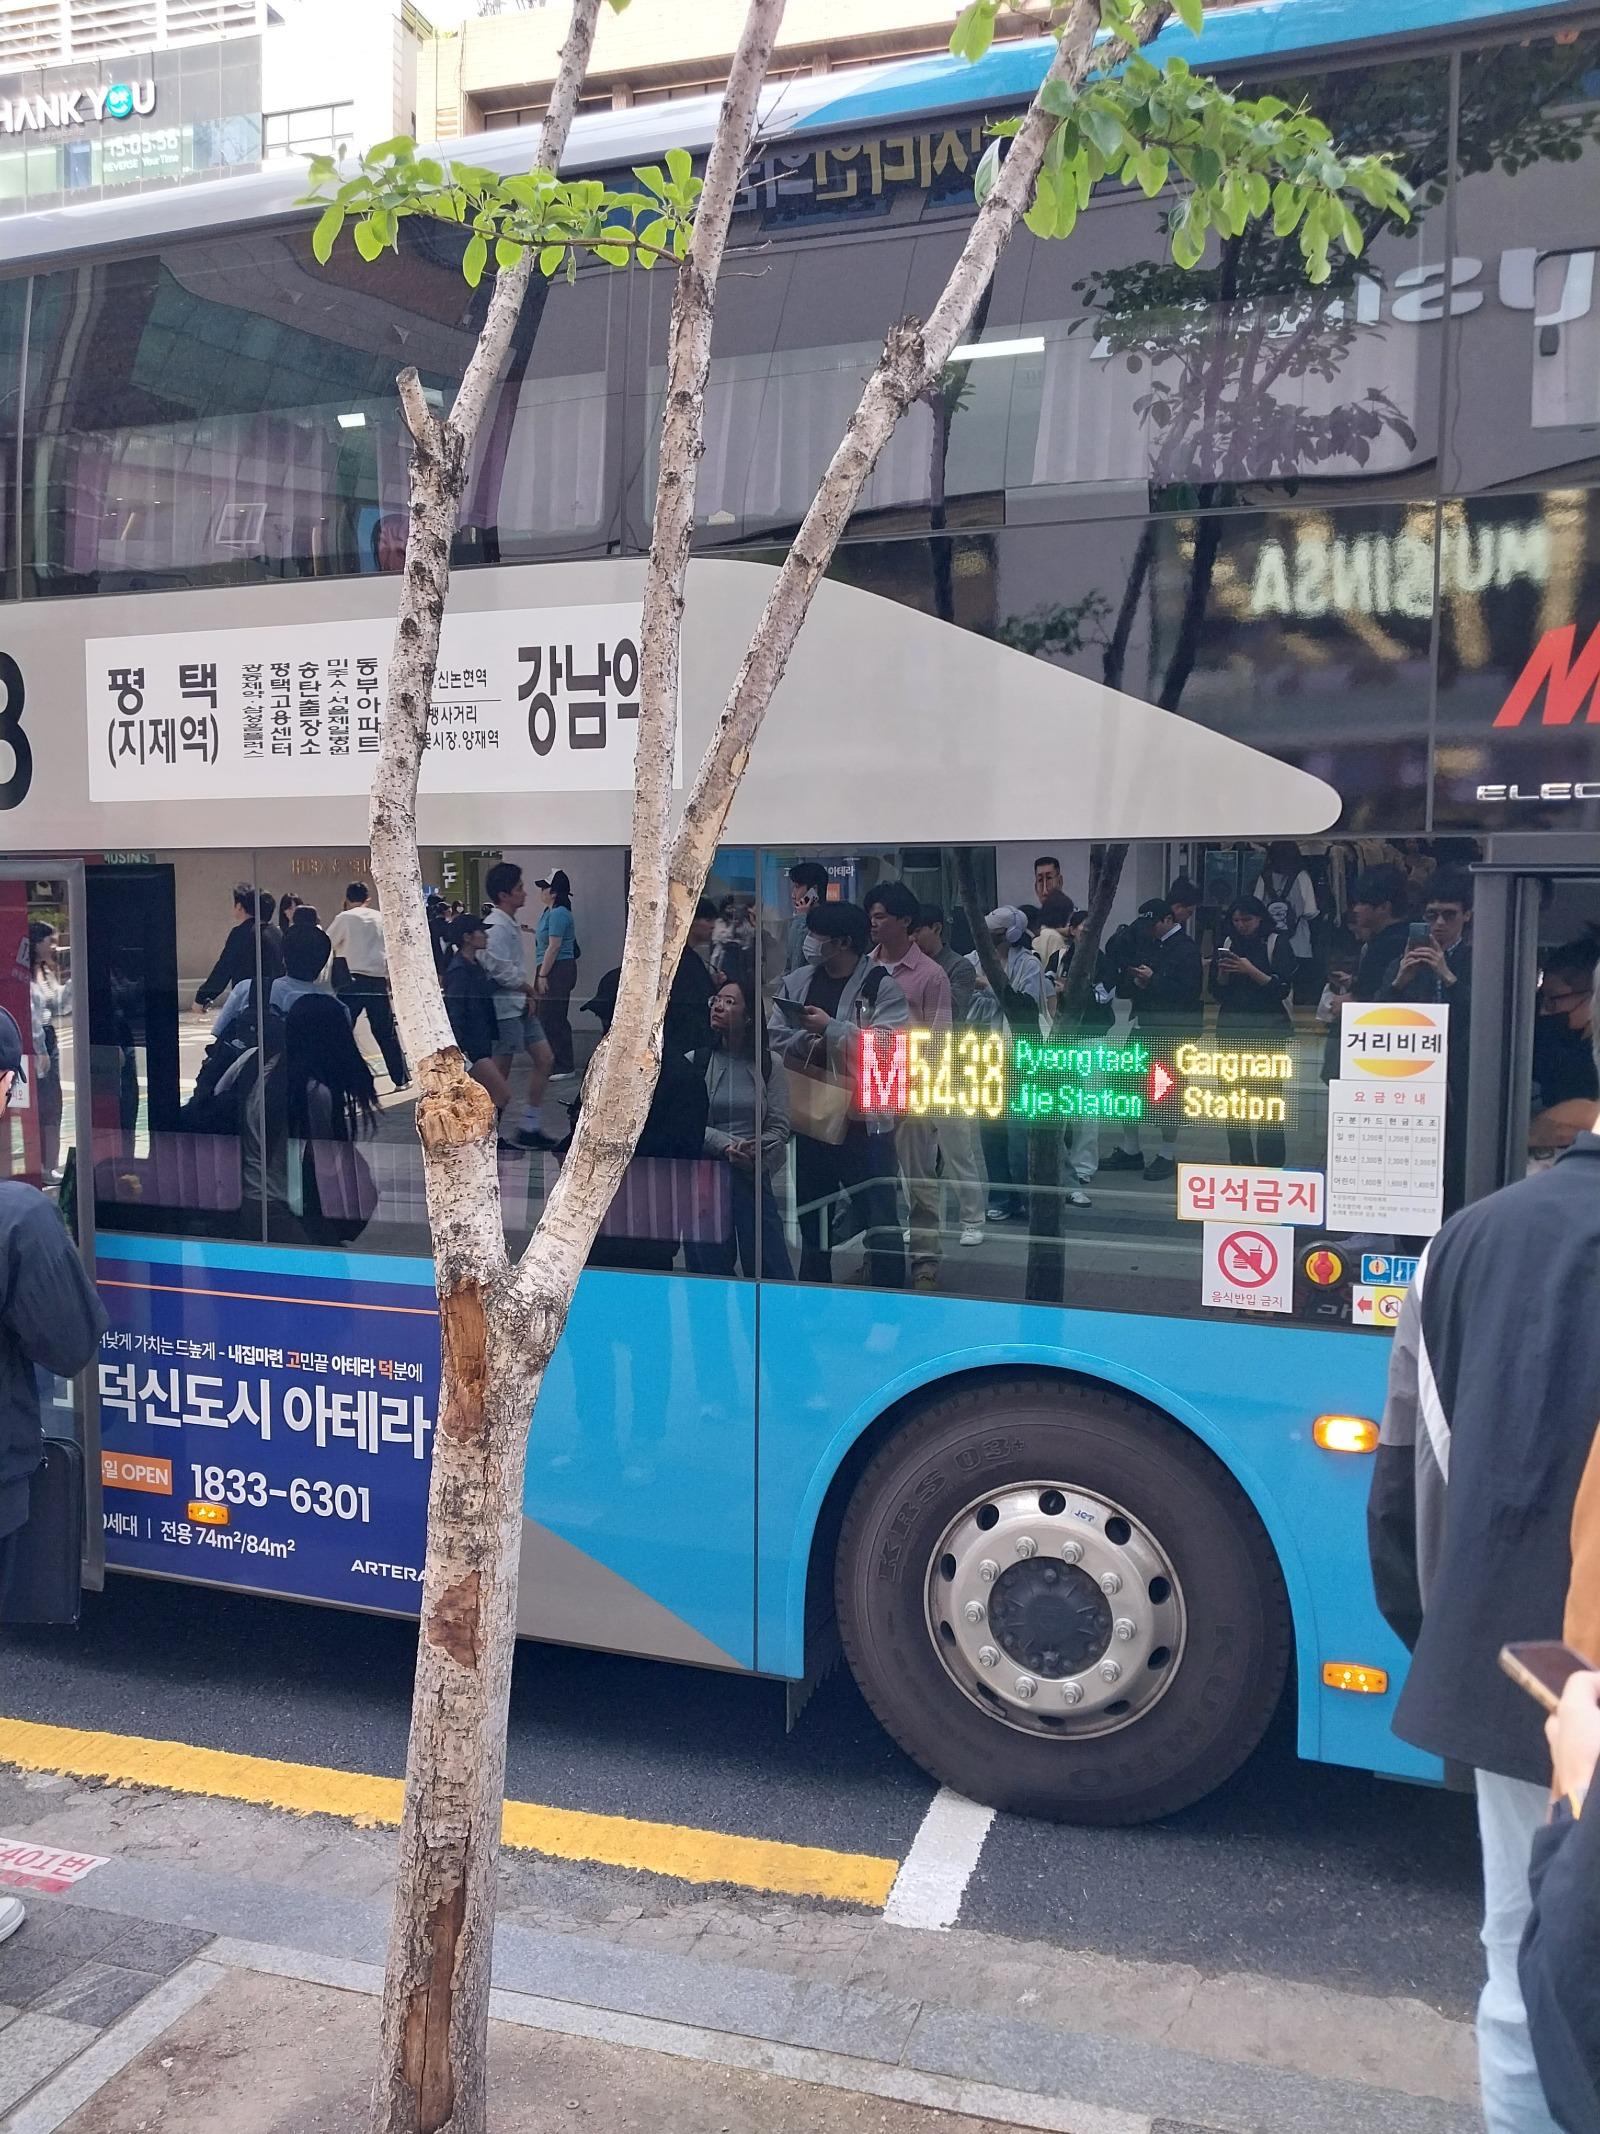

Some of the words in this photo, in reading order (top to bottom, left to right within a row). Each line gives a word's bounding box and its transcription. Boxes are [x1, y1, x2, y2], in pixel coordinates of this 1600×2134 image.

[269, 662, 292, 757] 평택고용센터
[298, 661, 322, 755] 송탄출장소
[355, 657, 381, 754] 동부아파트
[107, 712, 219, 769] (지제역)
[1346, 1031, 1443, 1055] 거리비례
[1182, 1085, 1287, 1123] Station
[1187, 1175, 1317, 1214] 입석금지
[134, 1334, 175, 1356] 가치는
[175, 1339, 216, 1361] 드높게
[228, 1344, 283, 1368] 내집마련
[286, 1350, 329, 1374] 고민끝
[331, 1354, 377, 1379] 아테라
[378, 1359, 423, 1383] 덕분에
[98, 1363, 271, 1441] 덕신도시
[282, 1384, 432, 1460] 아테라
[121, 1463, 169, 1486] OPEN
[190, 1463, 370, 1523] 1833-6301
[160, 1520, 193, 1546] 전용
[0, 1843, 97, 1878] 401번
